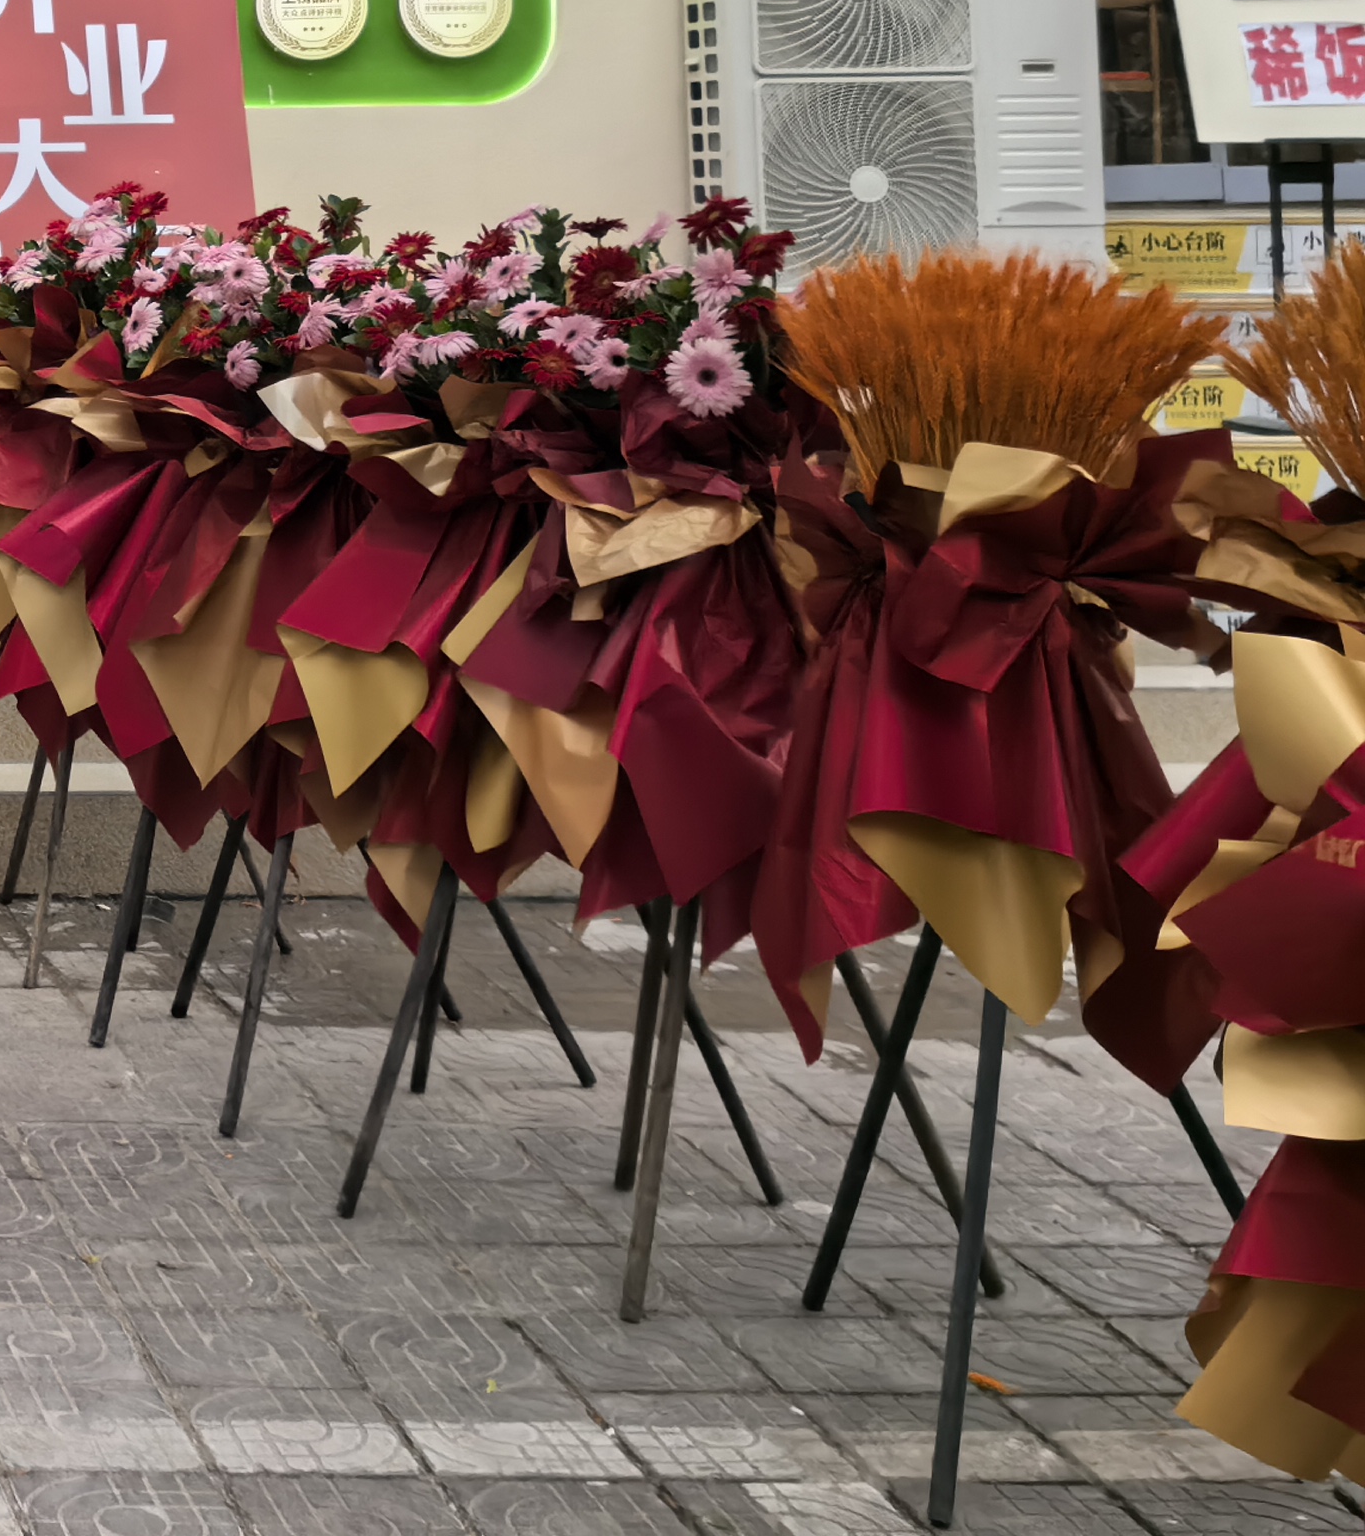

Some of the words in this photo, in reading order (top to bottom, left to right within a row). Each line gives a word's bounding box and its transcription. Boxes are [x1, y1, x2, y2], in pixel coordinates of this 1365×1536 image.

[1141, 231, 1226, 252] 小心台阶
[1237, 455, 1301, 478] 台阶
